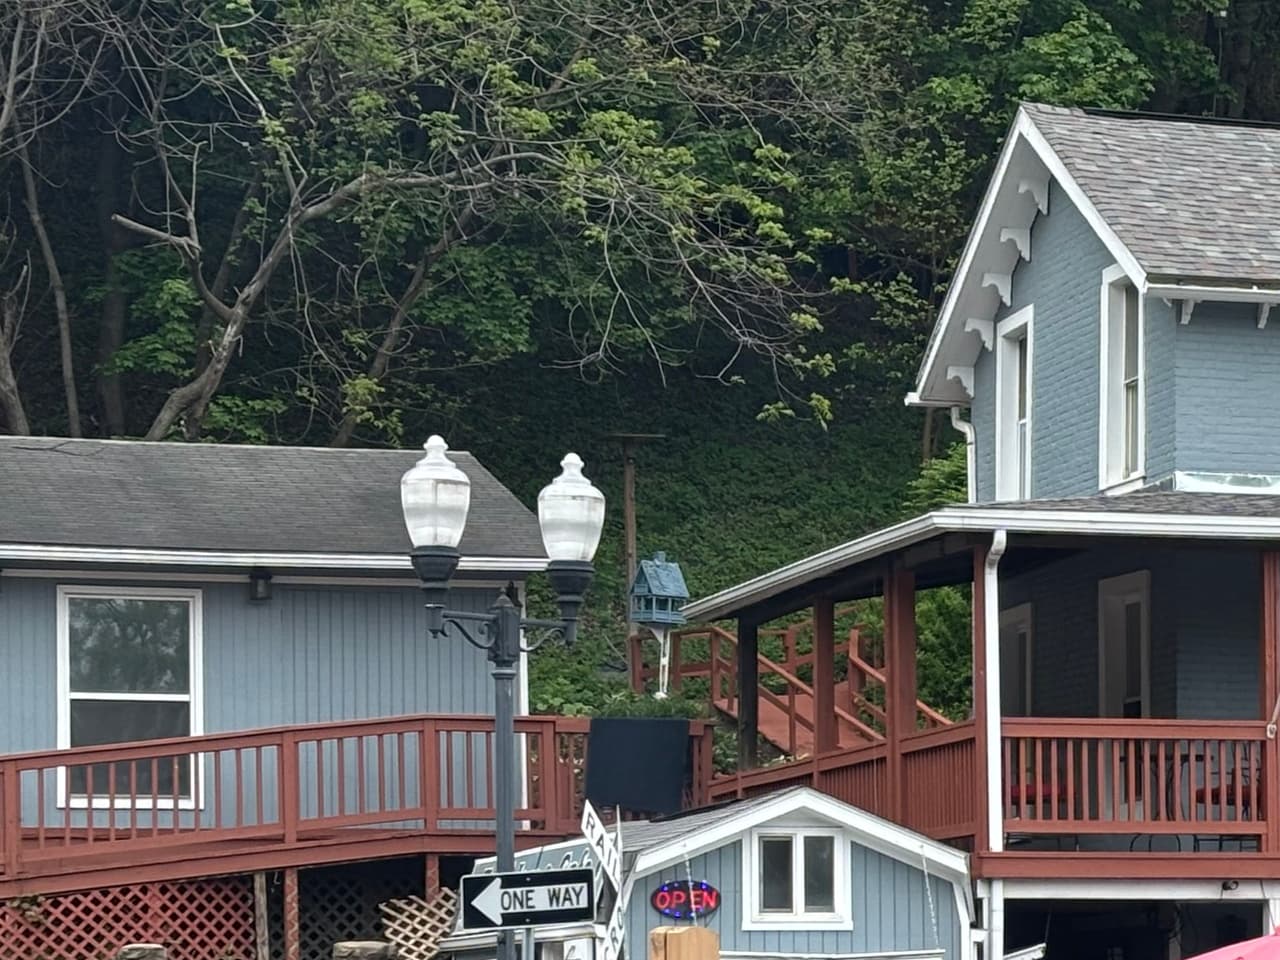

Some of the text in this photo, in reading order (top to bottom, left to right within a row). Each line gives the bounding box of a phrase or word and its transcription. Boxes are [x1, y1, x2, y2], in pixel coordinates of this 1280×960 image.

[501, 885, 585, 911] ONE WAY
[656, 889, 717, 911] OPEN
